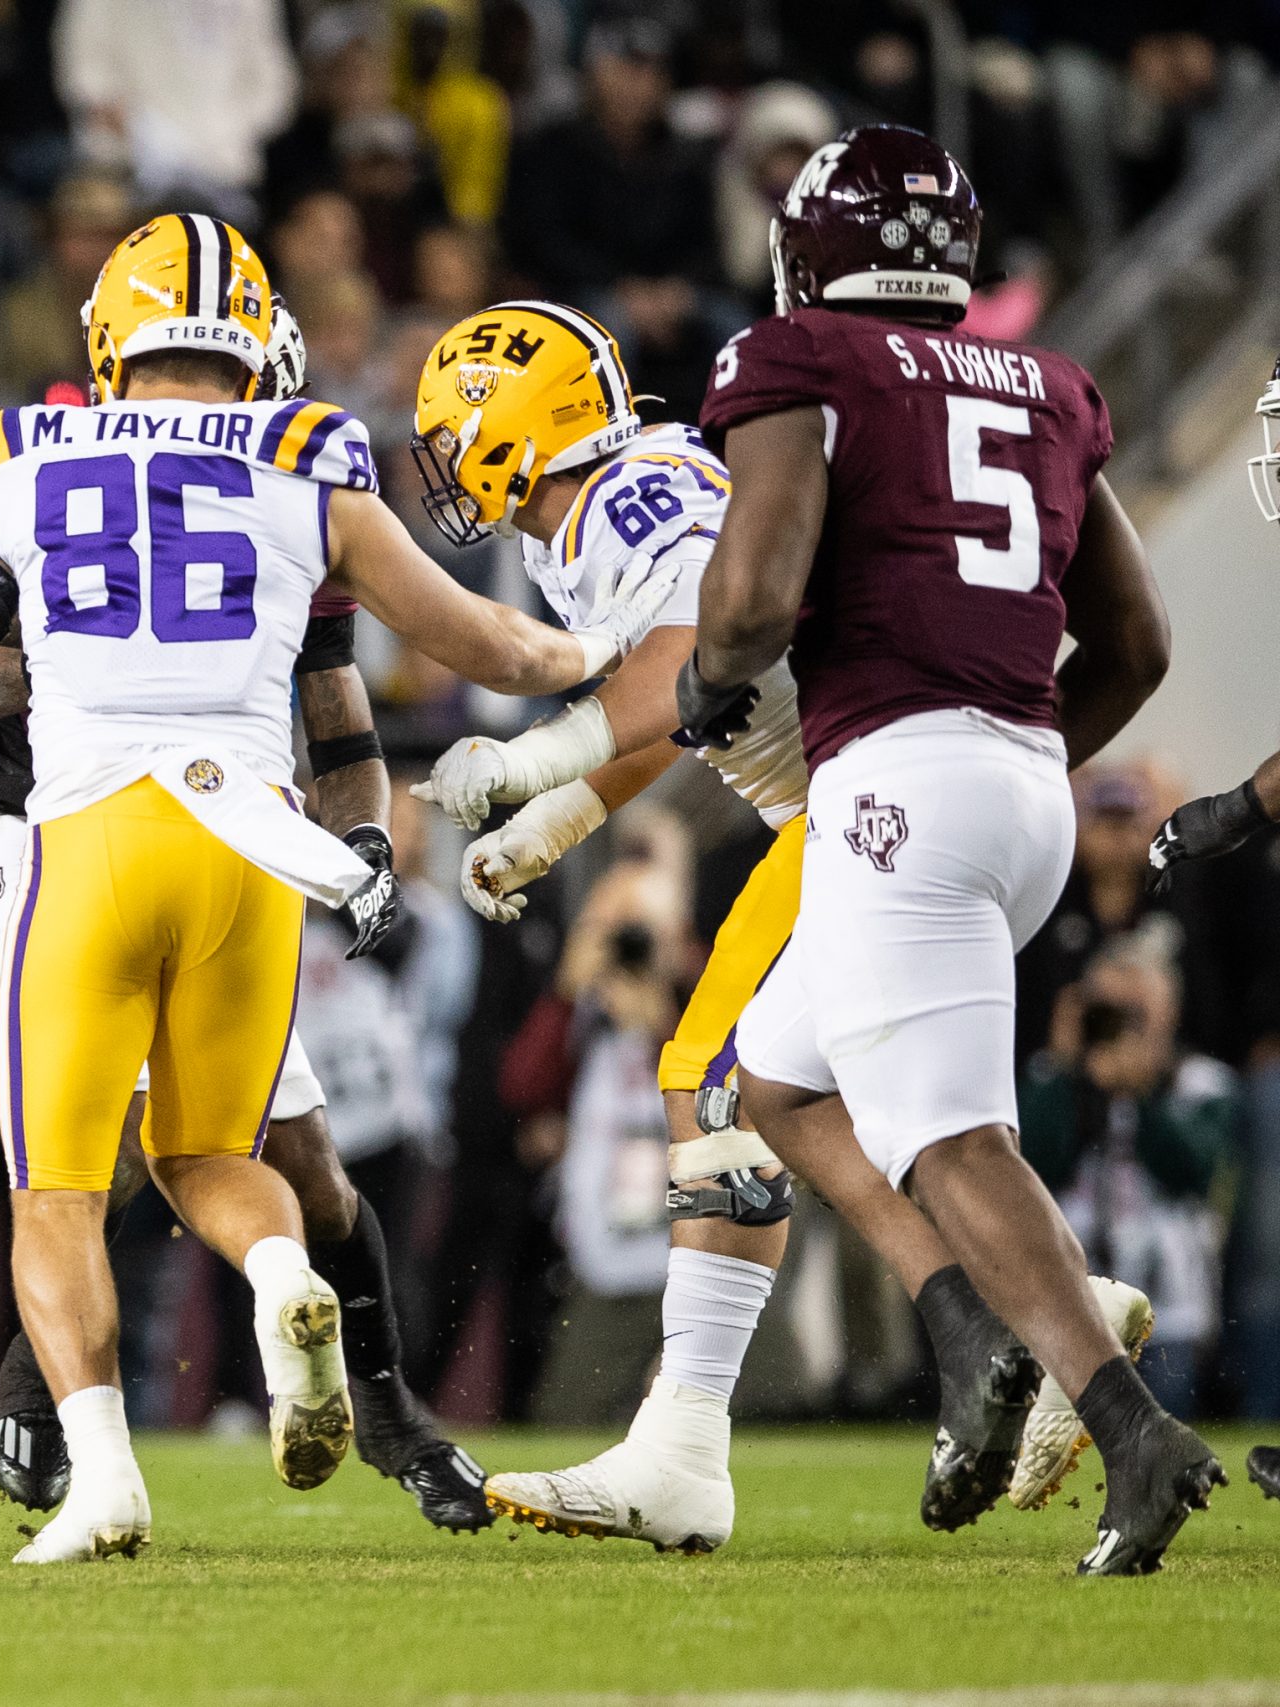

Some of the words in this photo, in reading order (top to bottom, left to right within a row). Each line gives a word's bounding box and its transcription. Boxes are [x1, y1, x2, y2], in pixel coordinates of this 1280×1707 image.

[913, 246, 925, 263] 5
[175, 290, 184, 305] 8
[233, 298, 241, 313] 6
[874, 279, 923, 294] TEXAS
[926, 281, 950, 297] A&M
[165, 325, 253, 350] TIGERS
[715, 327, 754, 390] 5
[885, 333, 931, 382] S.
[925, 337, 1046, 401] TURNER
[595, 400, 605, 415] 6
[32, 410, 73, 448] M.
[93, 412, 253, 455] TAYLOR
[604, 472, 684, 548] 66
[945, 394, 1041, 593] 5
[34, 452, 258, 644] 86
